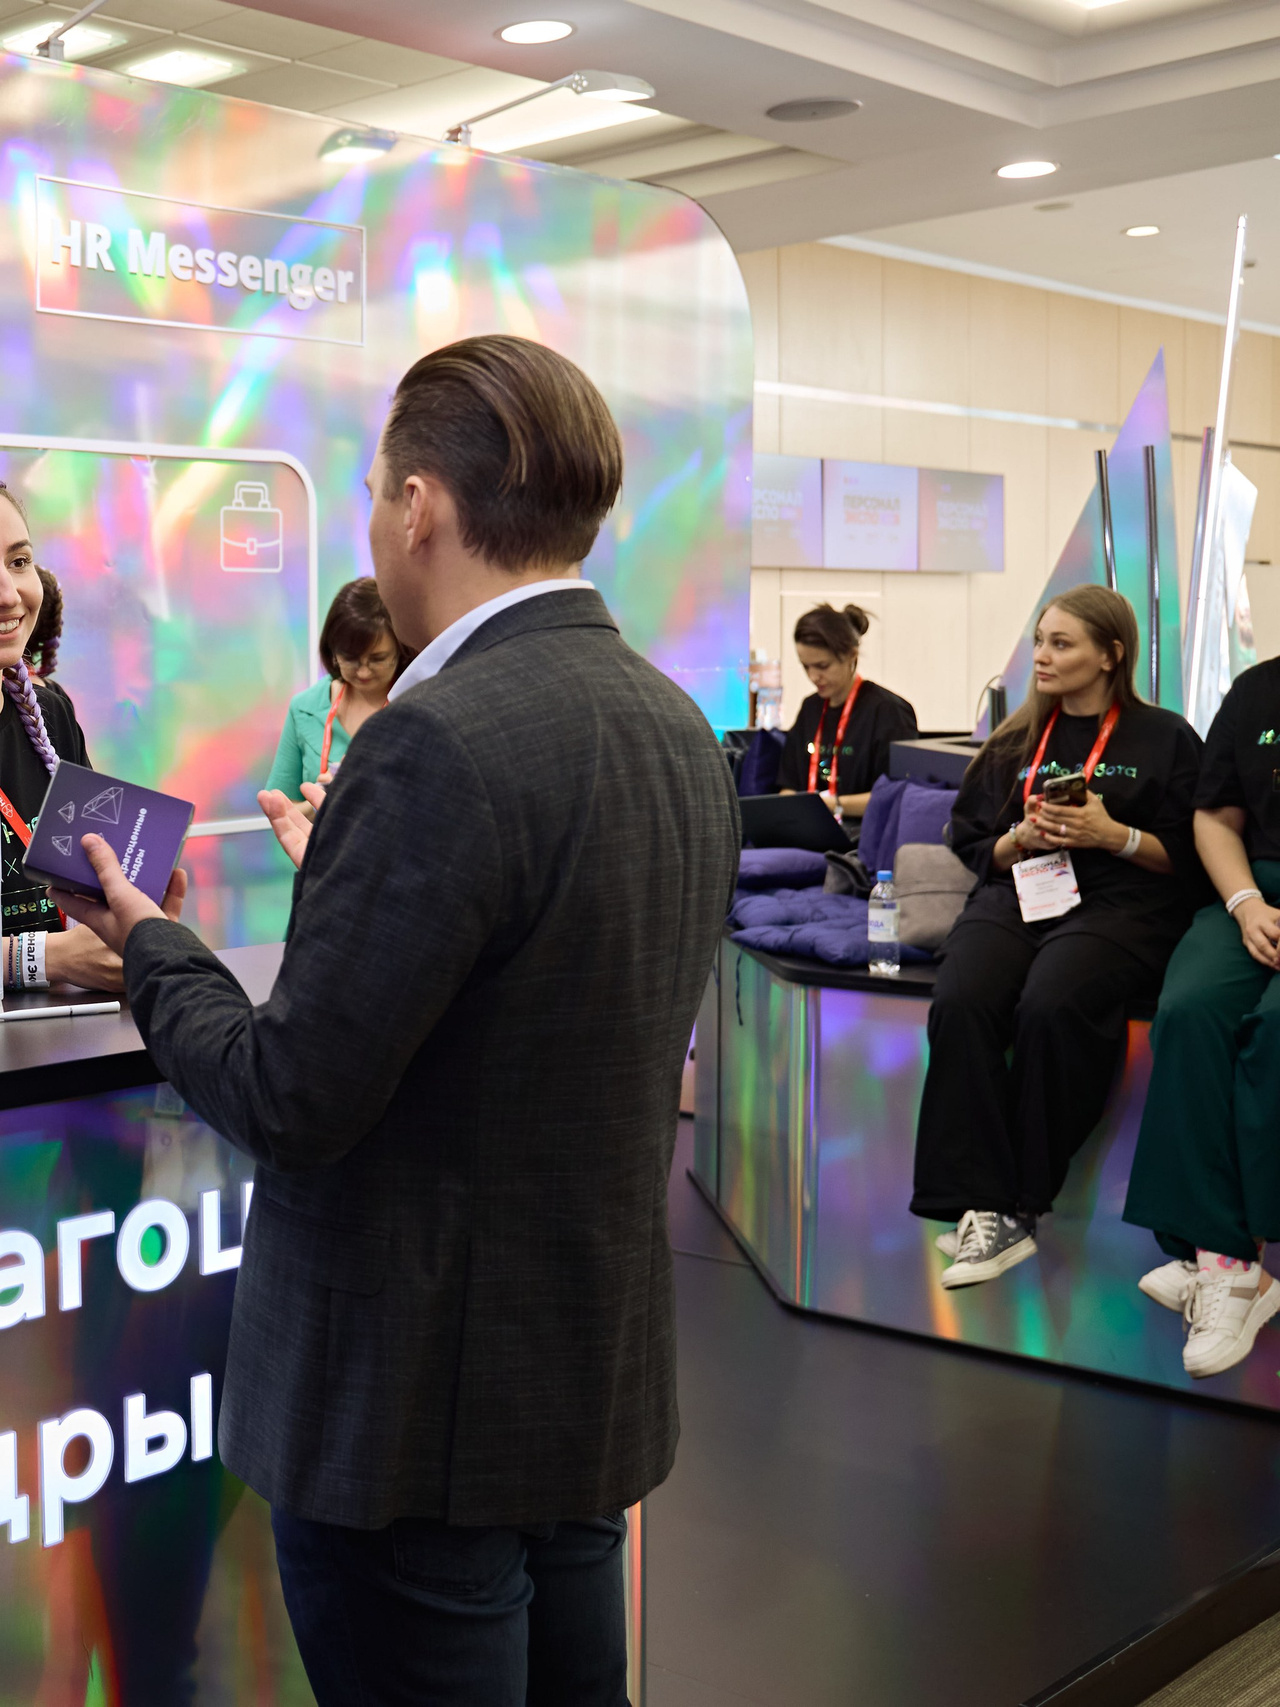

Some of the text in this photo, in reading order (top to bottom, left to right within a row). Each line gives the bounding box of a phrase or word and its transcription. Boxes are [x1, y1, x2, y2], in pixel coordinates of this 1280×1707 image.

[51, 218, 354, 310] HR Messenger
[1074, 762, 1137, 779] Рбота
[120, 807, 148, 875] рагоценные
[128, 848, 146, 883] кадры
[1, 898, 56, 917] essege
[27, 932, 36, 962] онал
